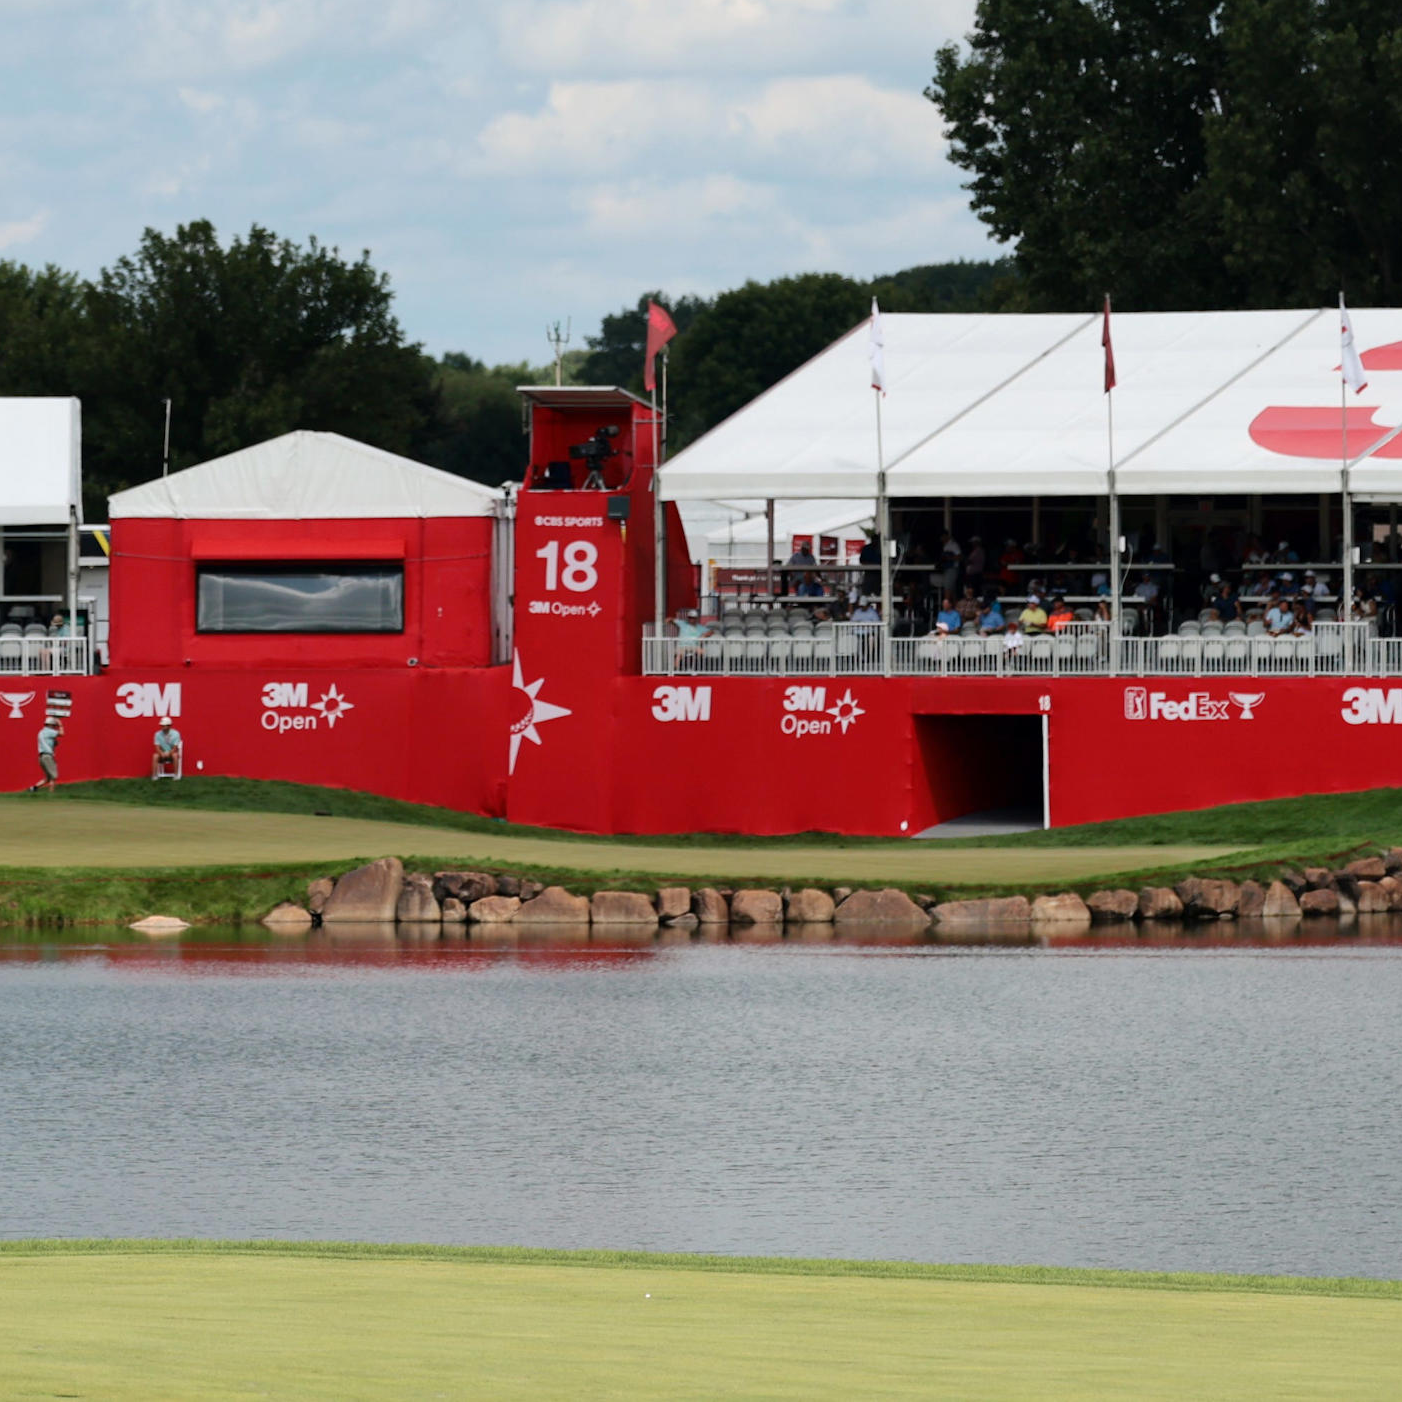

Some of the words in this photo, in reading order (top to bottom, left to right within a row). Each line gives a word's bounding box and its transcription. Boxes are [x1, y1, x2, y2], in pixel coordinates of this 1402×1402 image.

[542, 516, 563, 527] CBS
[564, 516, 603, 527] SPORTS
[536, 540, 598, 593] 18
[529, 601, 550, 614] 3M
[551, 601, 586, 617] Open
[115, 682, 182, 719] 3M
[261, 682, 308, 708] 3M
[652, 686, 711, 722] 3M
[782, 686, 826, 712] 3M
[1038, 694, 1051, 711] 18
[1150, 692, 1229, 721] FedEx
[261, 711, 317, 734] Open
[781, 713, 831, 738] Open
